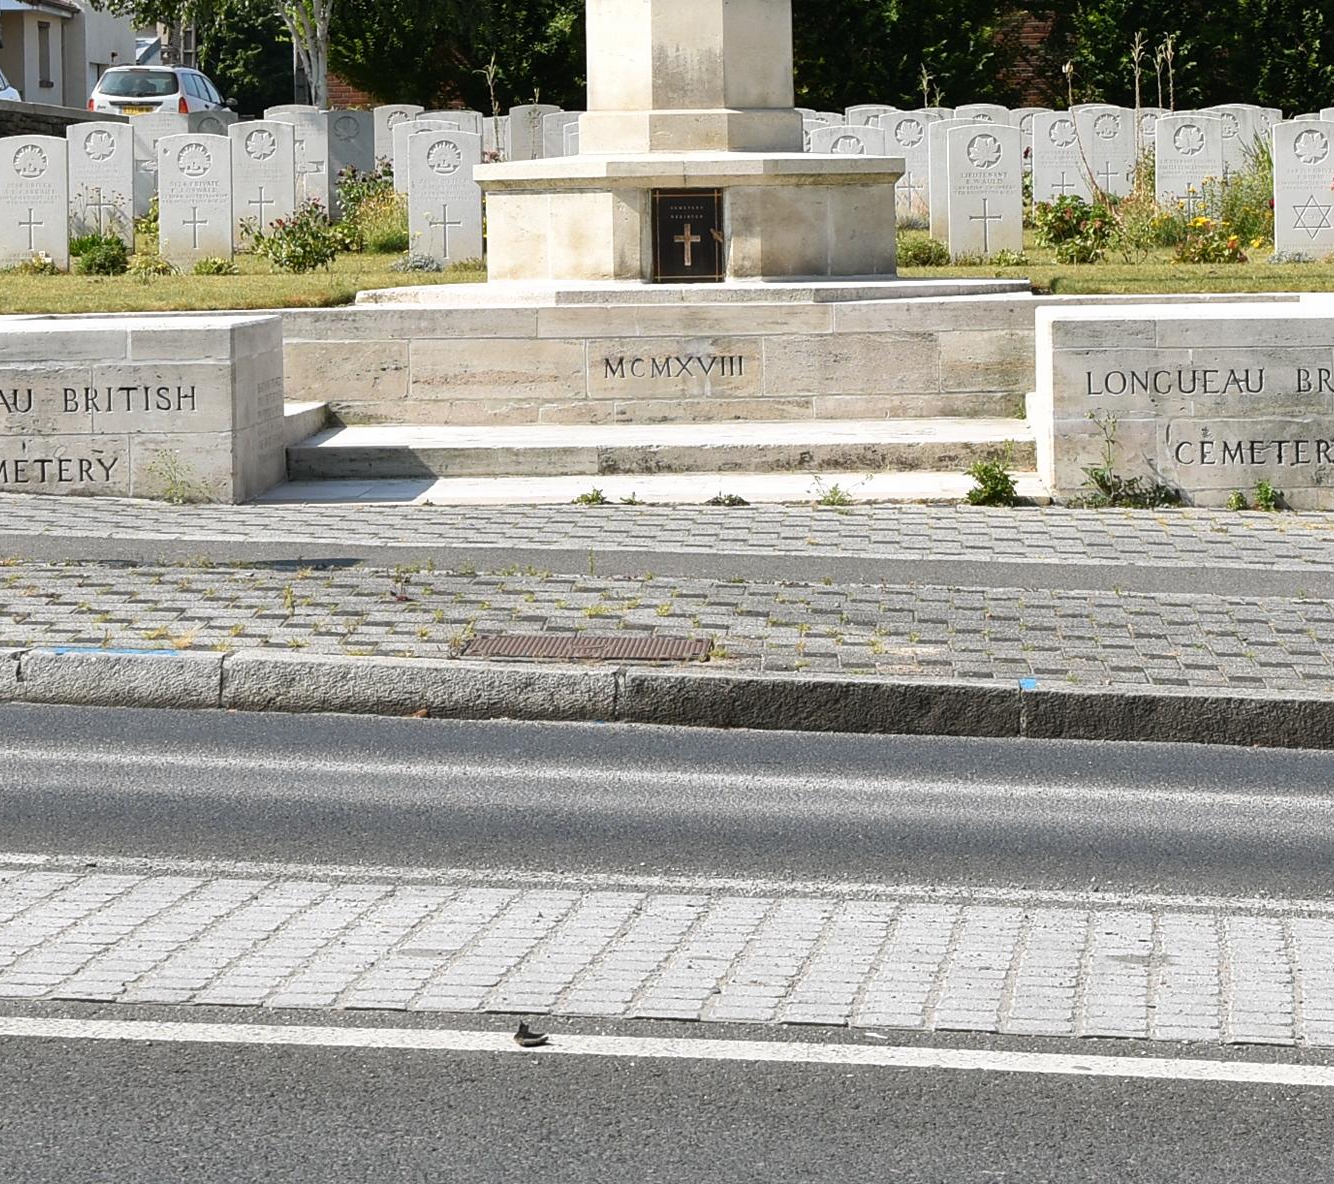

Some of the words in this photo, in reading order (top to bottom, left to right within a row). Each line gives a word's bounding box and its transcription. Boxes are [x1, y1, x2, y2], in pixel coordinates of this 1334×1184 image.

[604, 355, 745, 379] MCMXVIII
[1086, 369, 1265, 396] LONGUEAU
[63, 386, 197, 413] BRITISH
